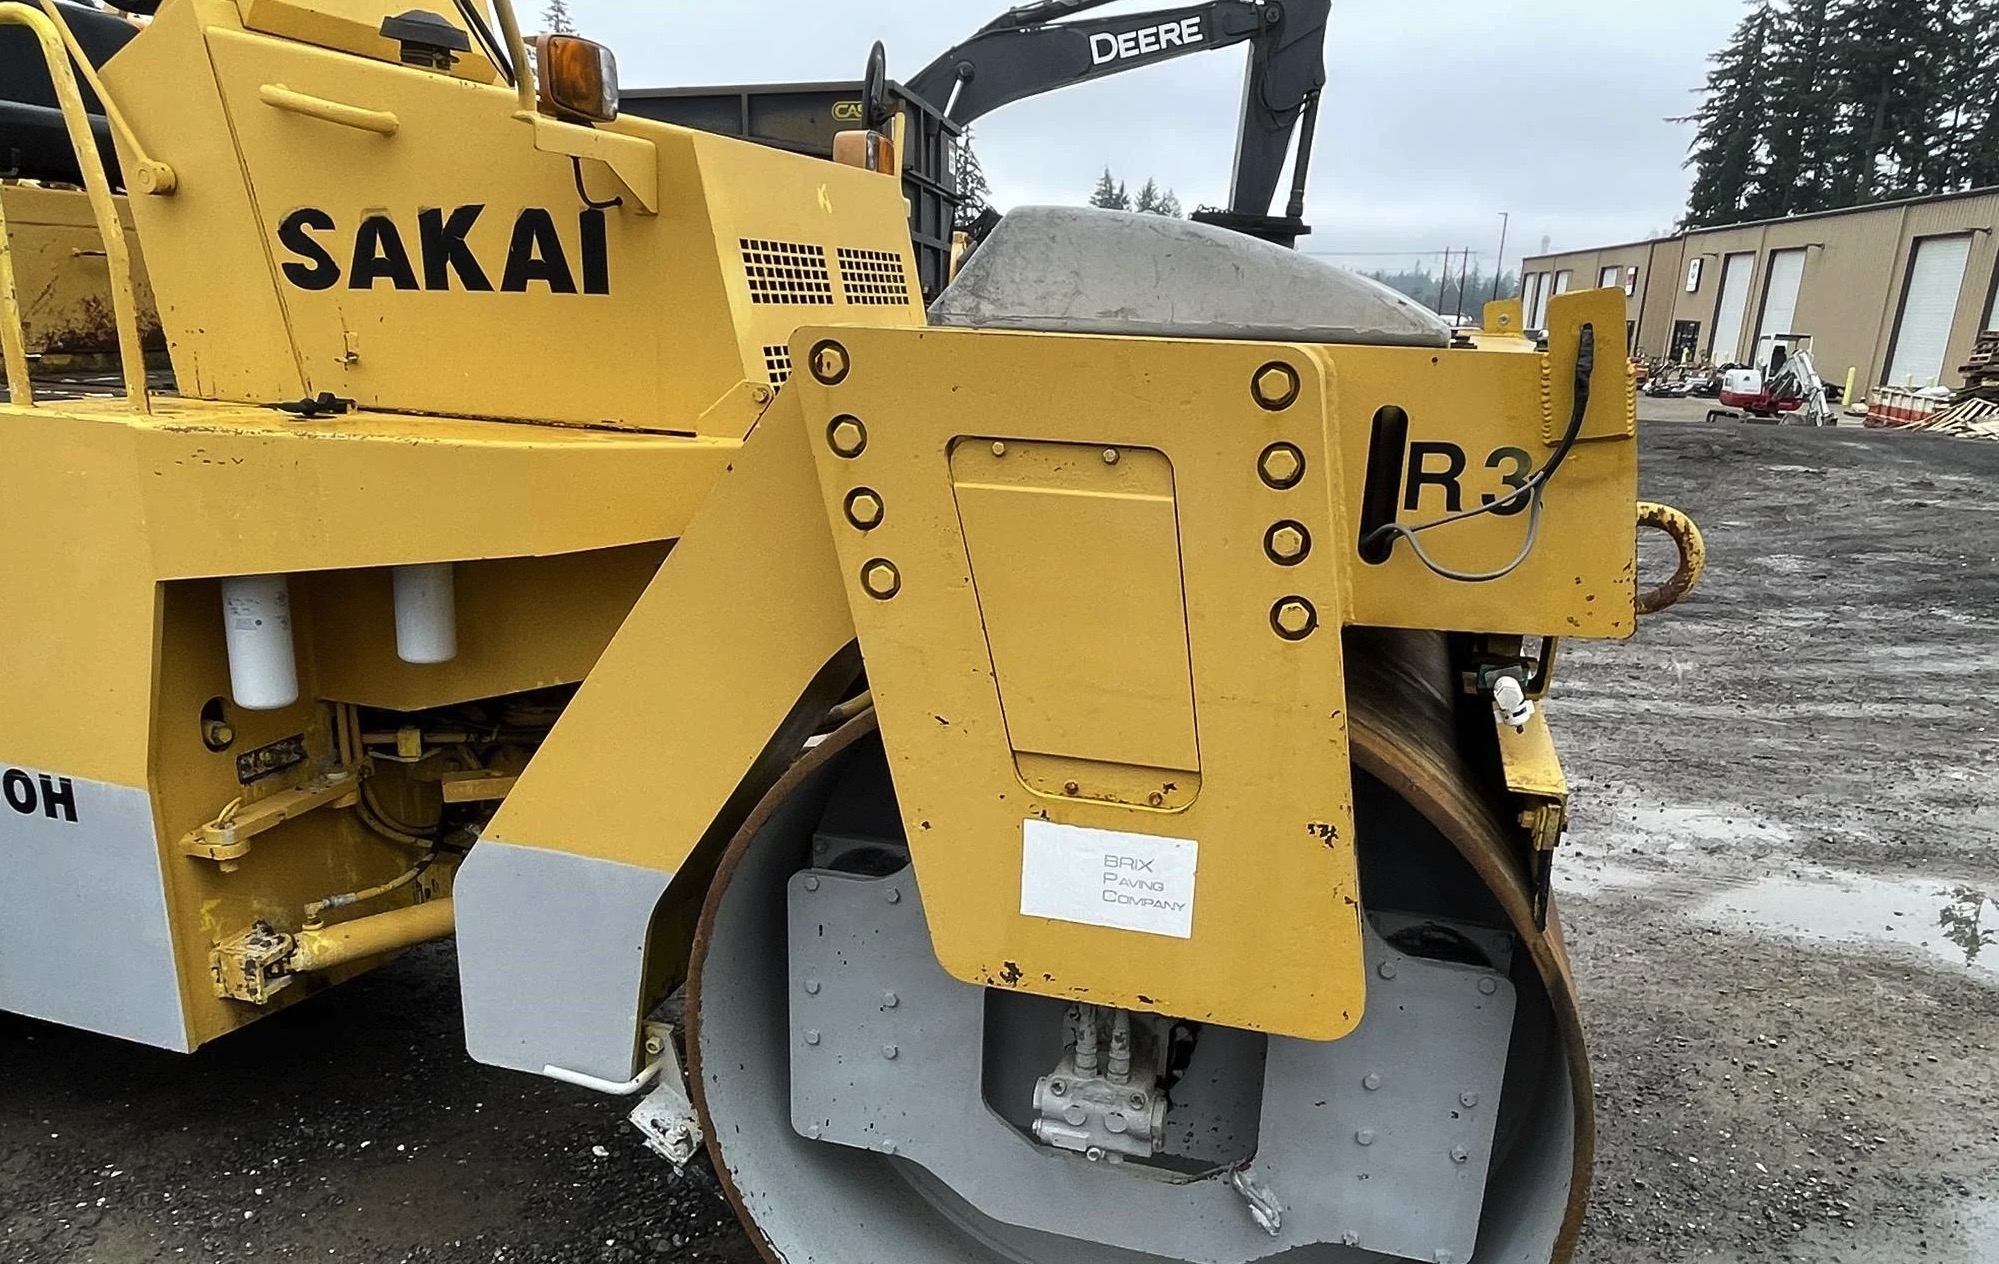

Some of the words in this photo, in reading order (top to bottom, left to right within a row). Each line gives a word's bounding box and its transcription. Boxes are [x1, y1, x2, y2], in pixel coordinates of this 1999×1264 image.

[1089, 16, 1203, 65] DEERE
[277, 203, 610, 294] SAKAI
[1104, 854, 1154, 873] BRIX
